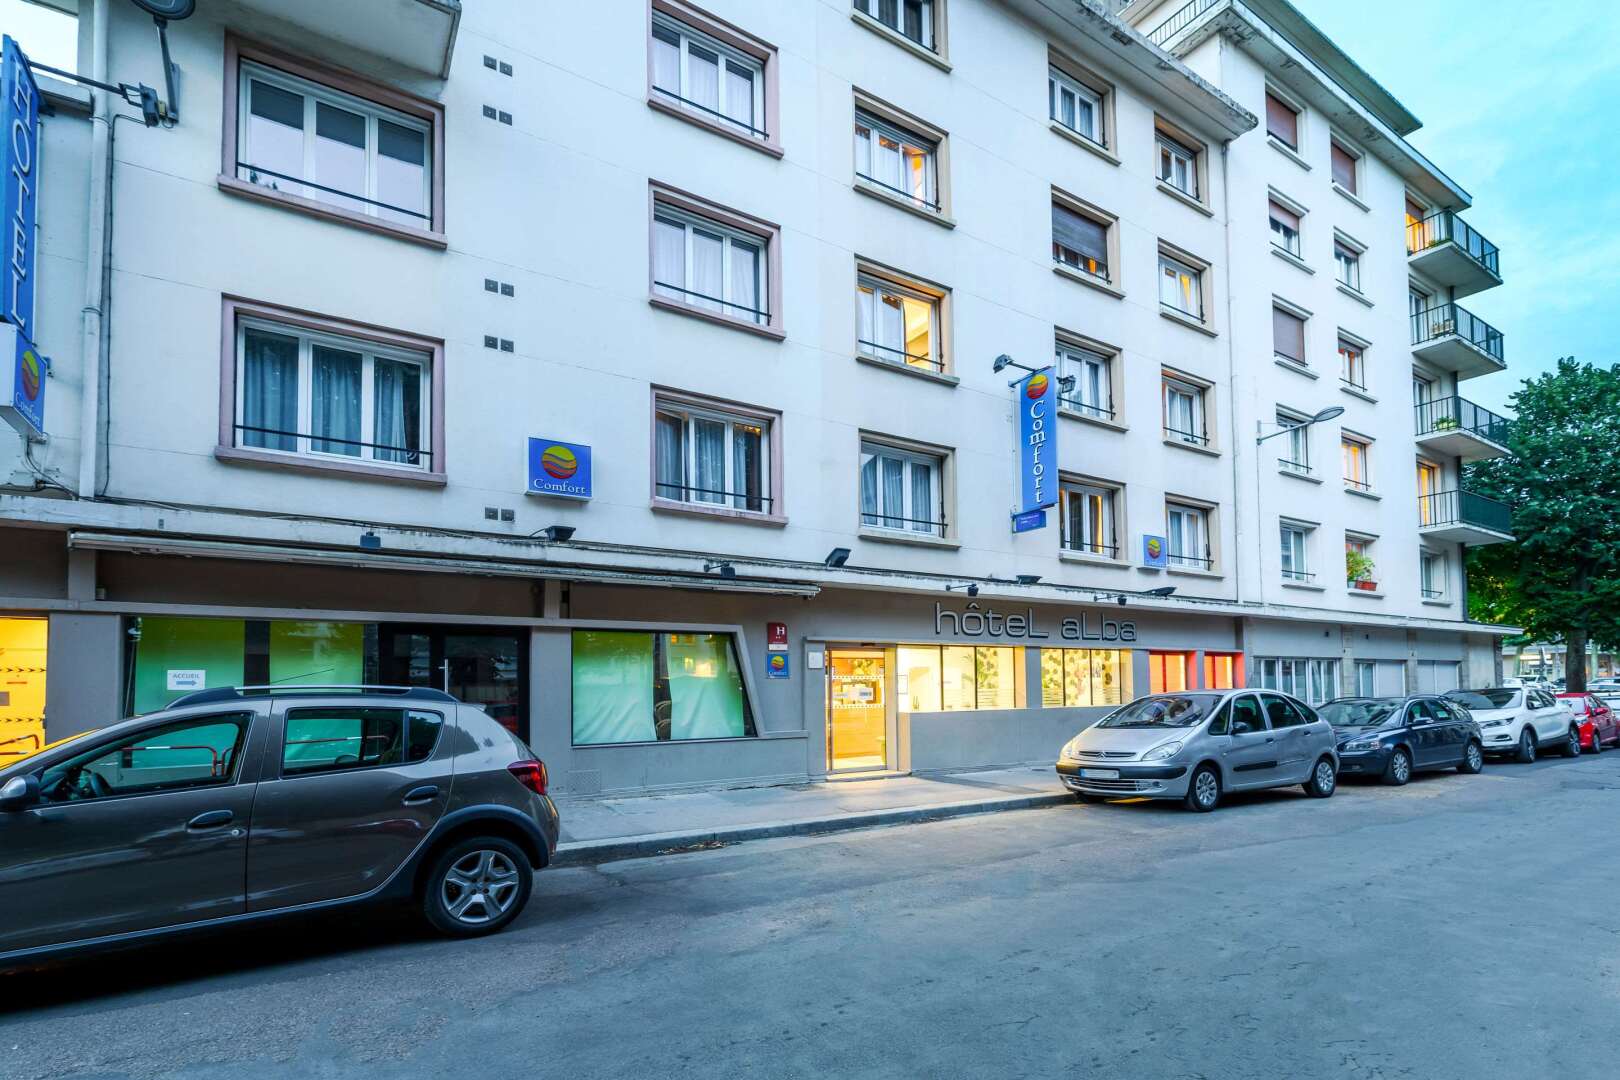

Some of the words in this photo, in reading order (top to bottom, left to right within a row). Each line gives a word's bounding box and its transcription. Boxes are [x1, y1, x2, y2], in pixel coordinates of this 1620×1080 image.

[12, 57, 32, 329] HOTEL
[1029, 400, 1046, 503] Comfort
[534, 478, 586, 494] Comfort
[776, 626, 785, 635] H
